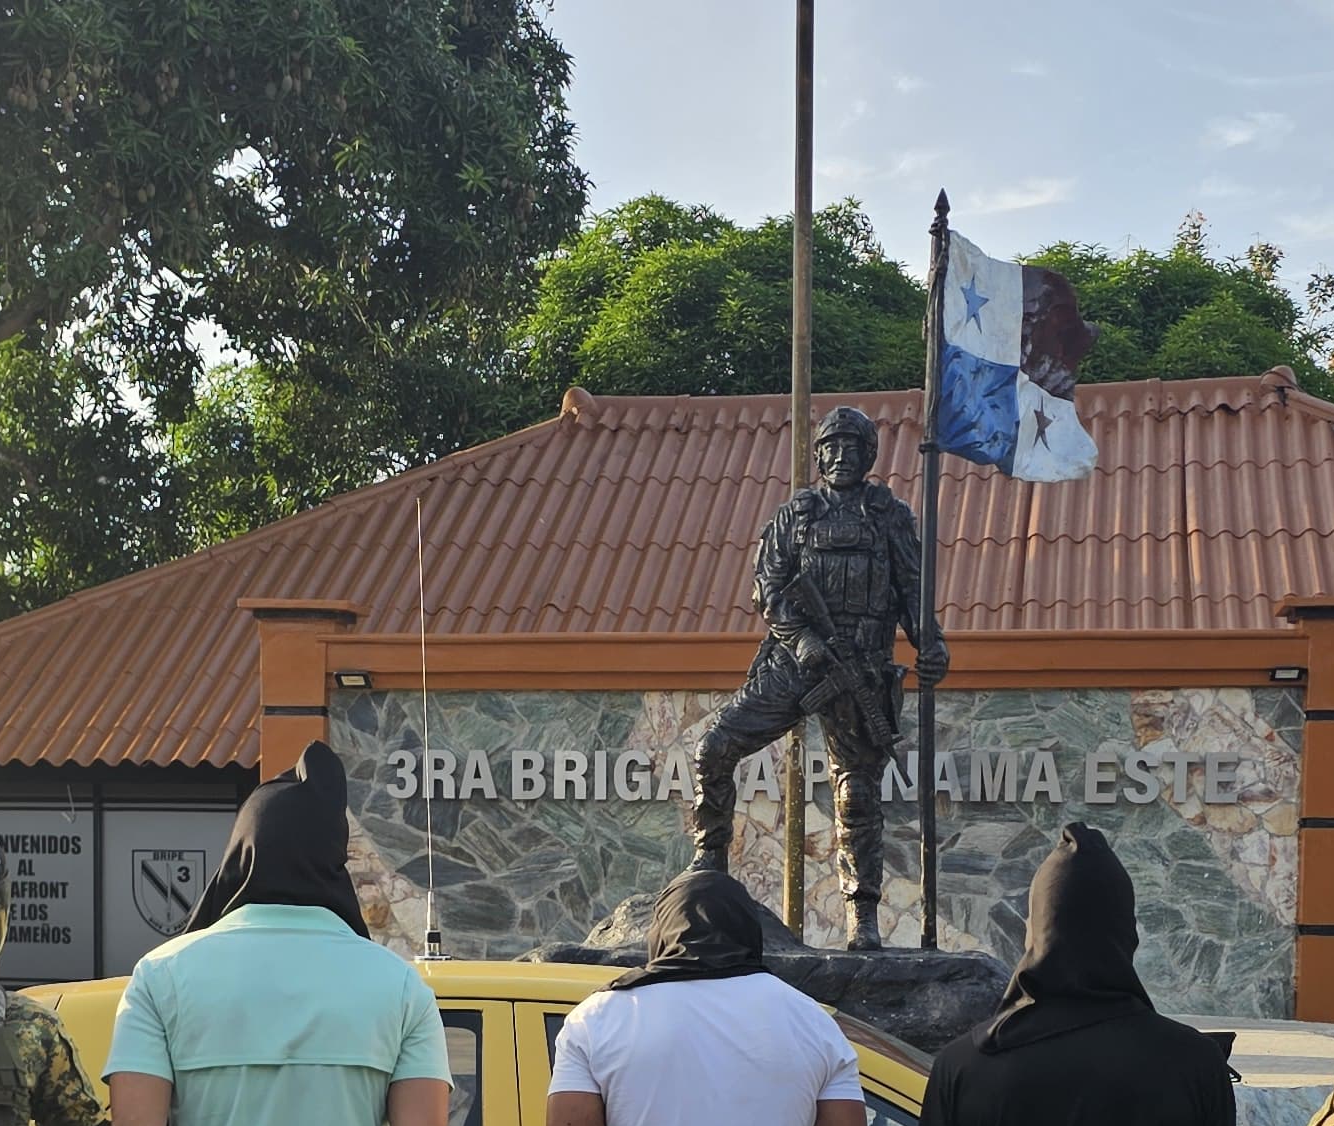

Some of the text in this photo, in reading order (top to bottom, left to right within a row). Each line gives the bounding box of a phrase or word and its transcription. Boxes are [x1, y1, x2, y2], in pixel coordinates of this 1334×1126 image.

[386, 749, 498, 800] 3RA
[511, 749, 781, 801] BRIGAA
[1085, 750, 1238, 804] ESTE
[17, 859, 35, 876] AL
[177, 866, 190, 883] 3
[11, 881, 69, 899] AFRONT
[21, 904, 48, 921] LOS
[8, 923, 71, 944] AMEÑOS
